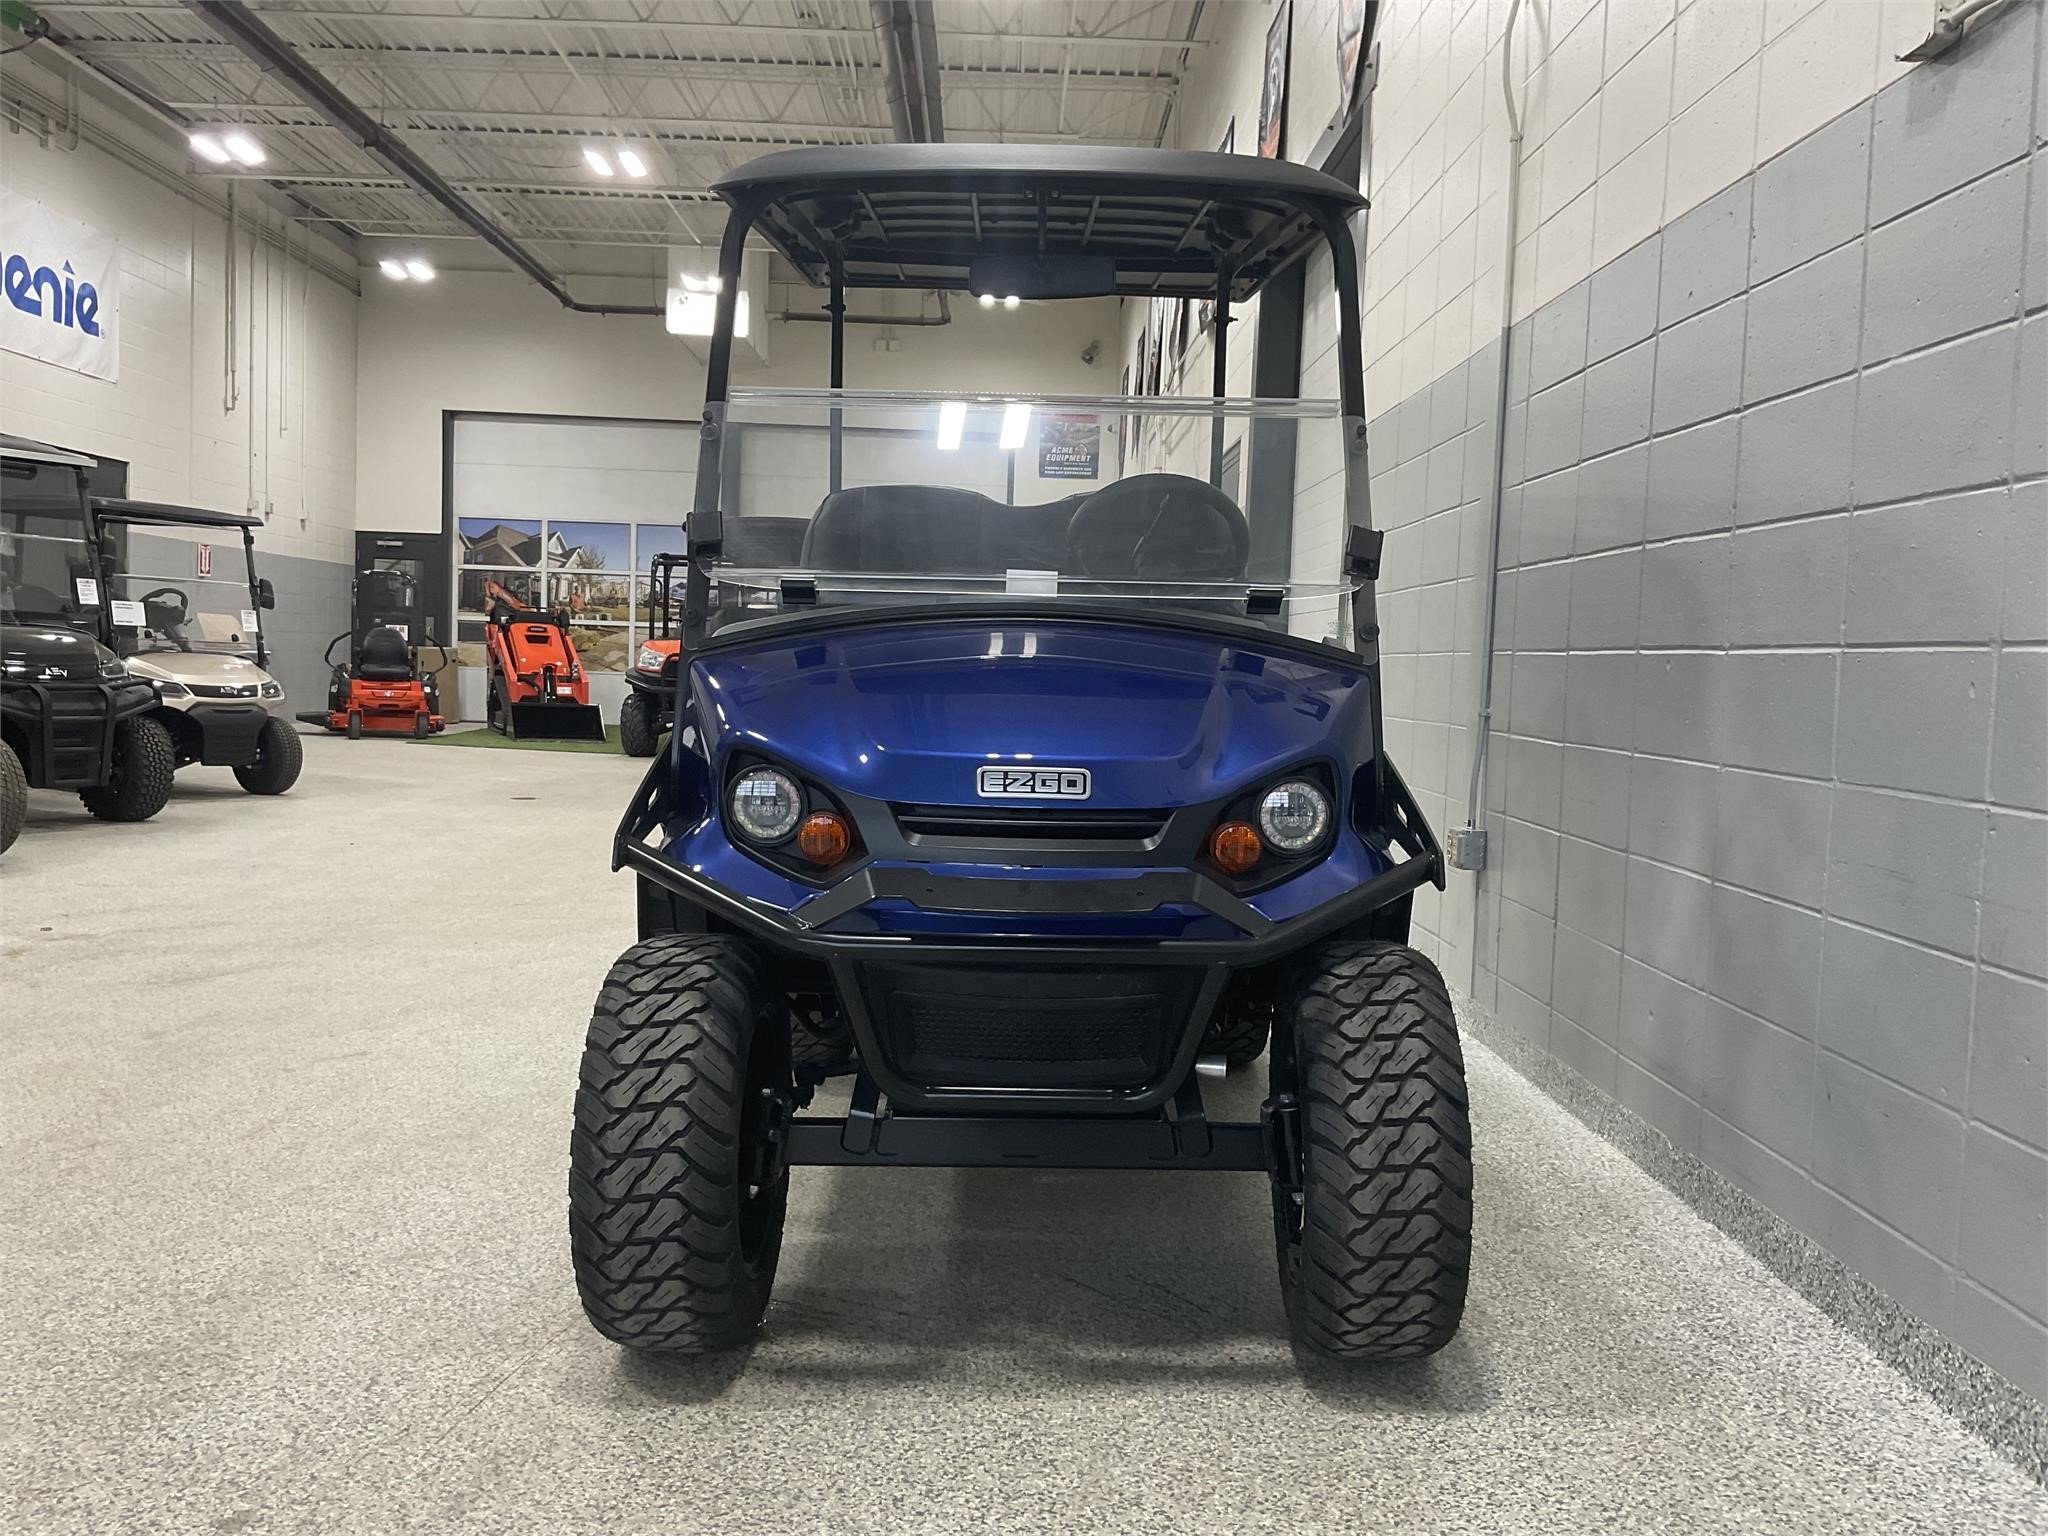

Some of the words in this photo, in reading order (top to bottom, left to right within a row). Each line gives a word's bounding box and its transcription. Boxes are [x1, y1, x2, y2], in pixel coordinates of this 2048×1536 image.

[0, 250, 100, 338] enie
[1046, 454, 1091, 462] EQUIPMENT
[983, 771, 1084, 794] EZGO
